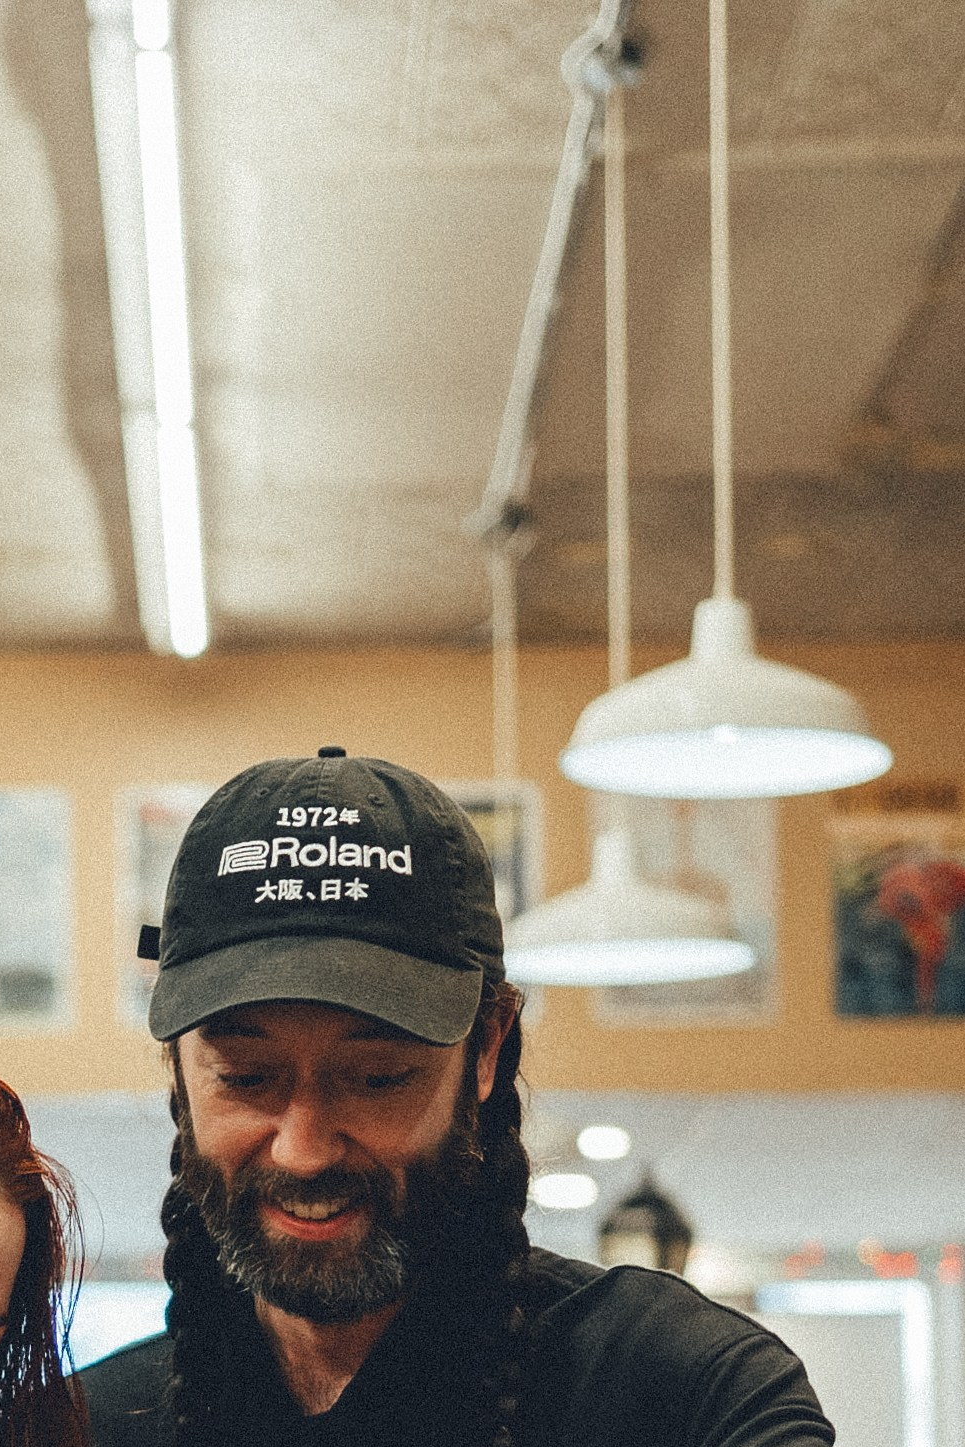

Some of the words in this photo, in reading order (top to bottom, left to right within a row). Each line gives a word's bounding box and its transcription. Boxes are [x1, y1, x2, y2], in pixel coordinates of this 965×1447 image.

[275, 806, 361, 828] 1972年
[271, 836, 412, 876] Roland
[254, 877, 370, 903] 大阪、日本
